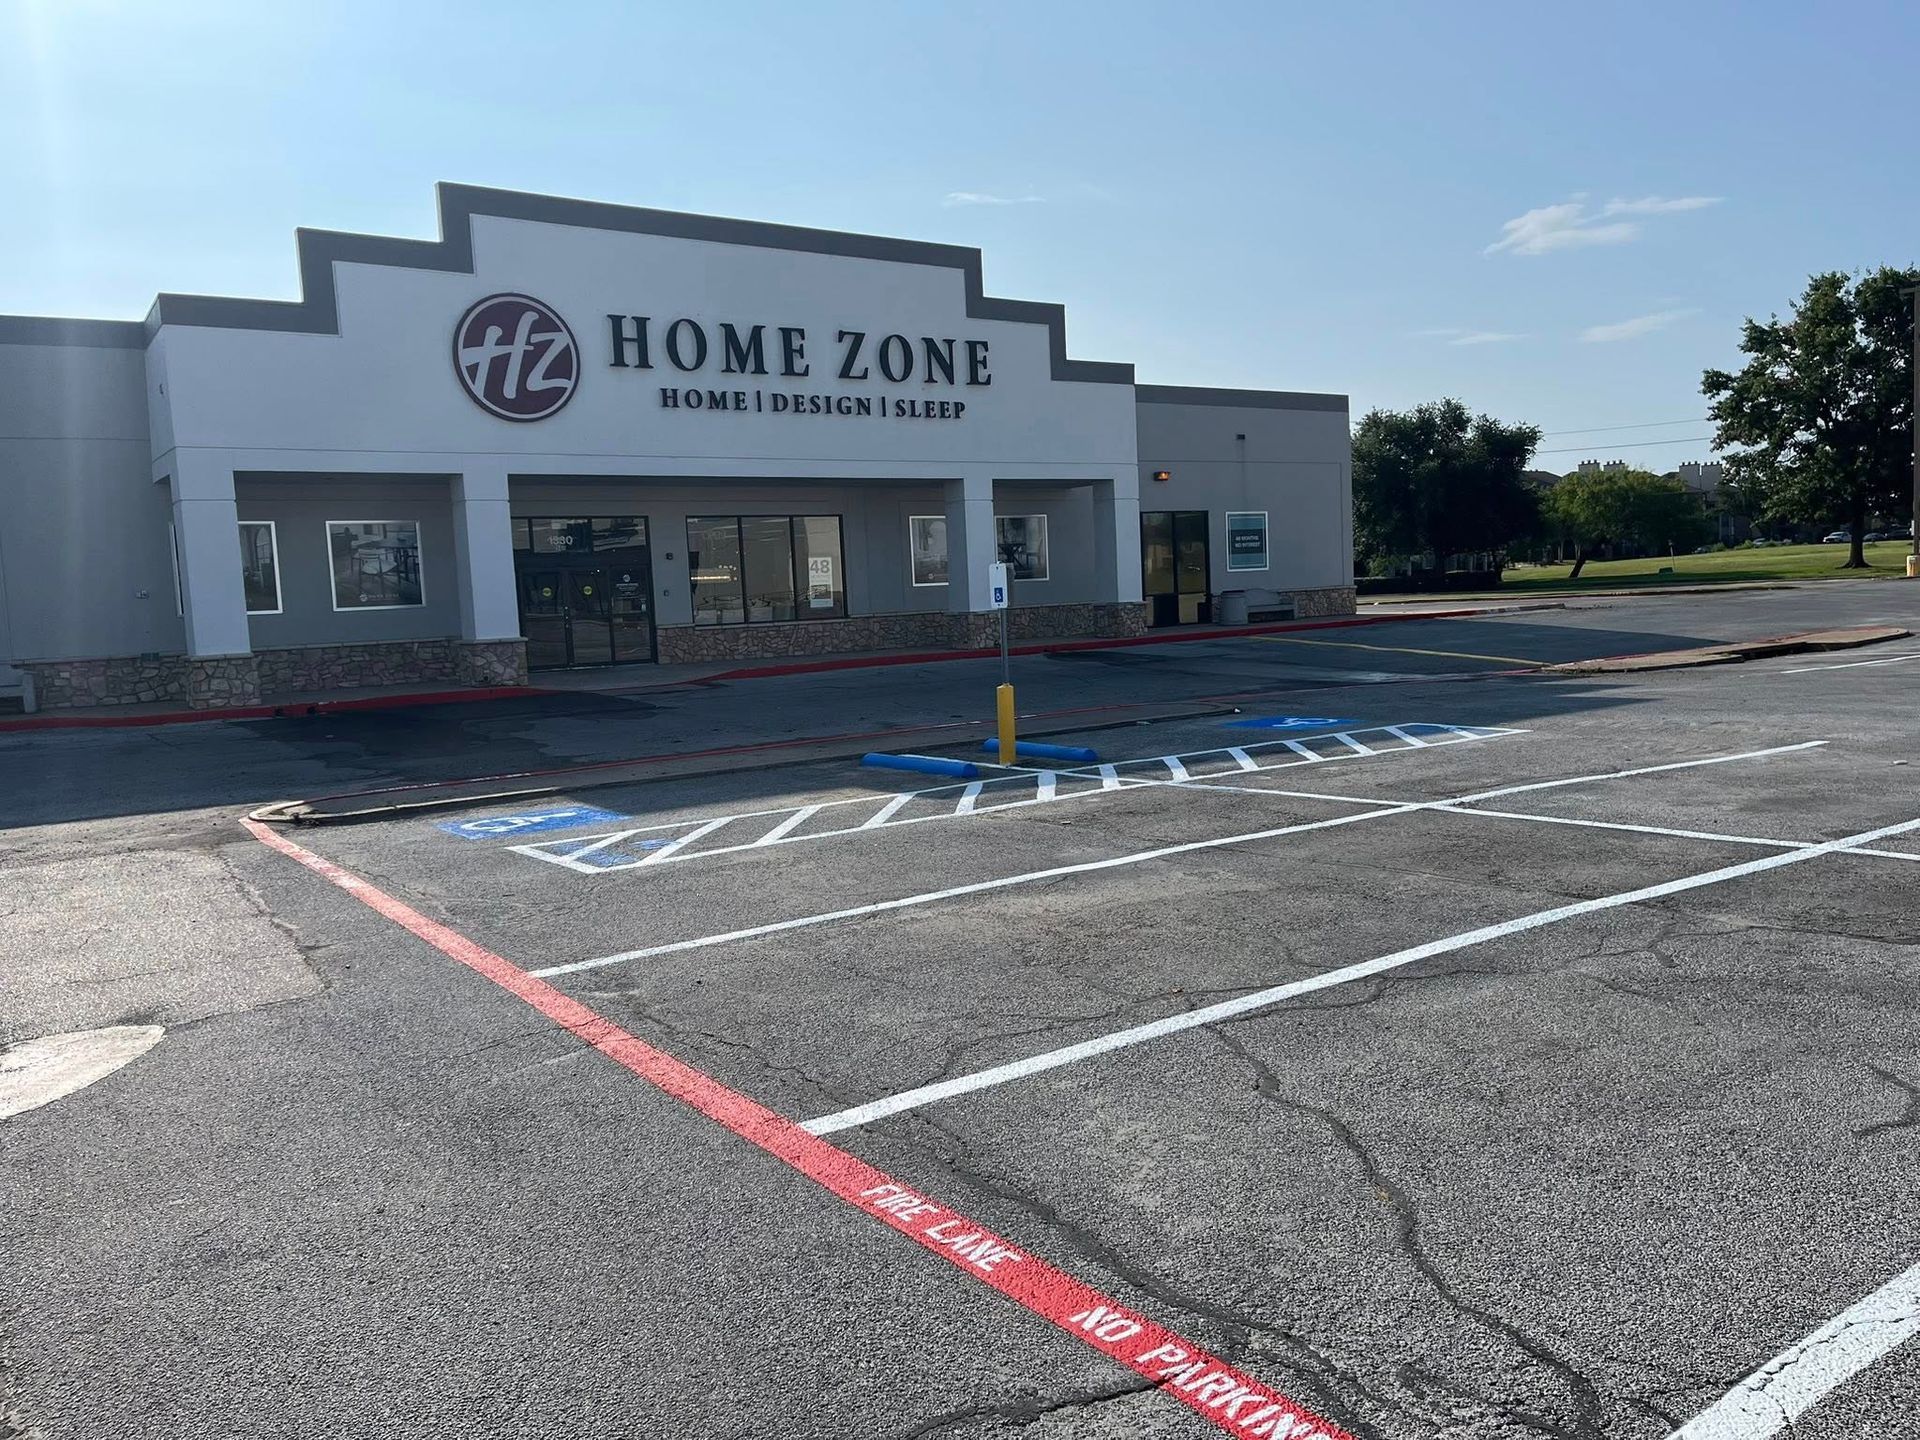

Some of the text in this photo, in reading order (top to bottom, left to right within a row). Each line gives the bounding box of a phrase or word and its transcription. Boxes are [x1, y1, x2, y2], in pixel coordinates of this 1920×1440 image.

[608, 314, 992, 387] HOME ZONE
[659, 388, 966, 420] HOME DESIGN SLEEP
[810, 560, 830, 573] 48
[860, 1184, 939, 1222] FIRE
[924, 1220, 1022, 1271] LANE
[1070, 1306, 1142, 1342] NO
